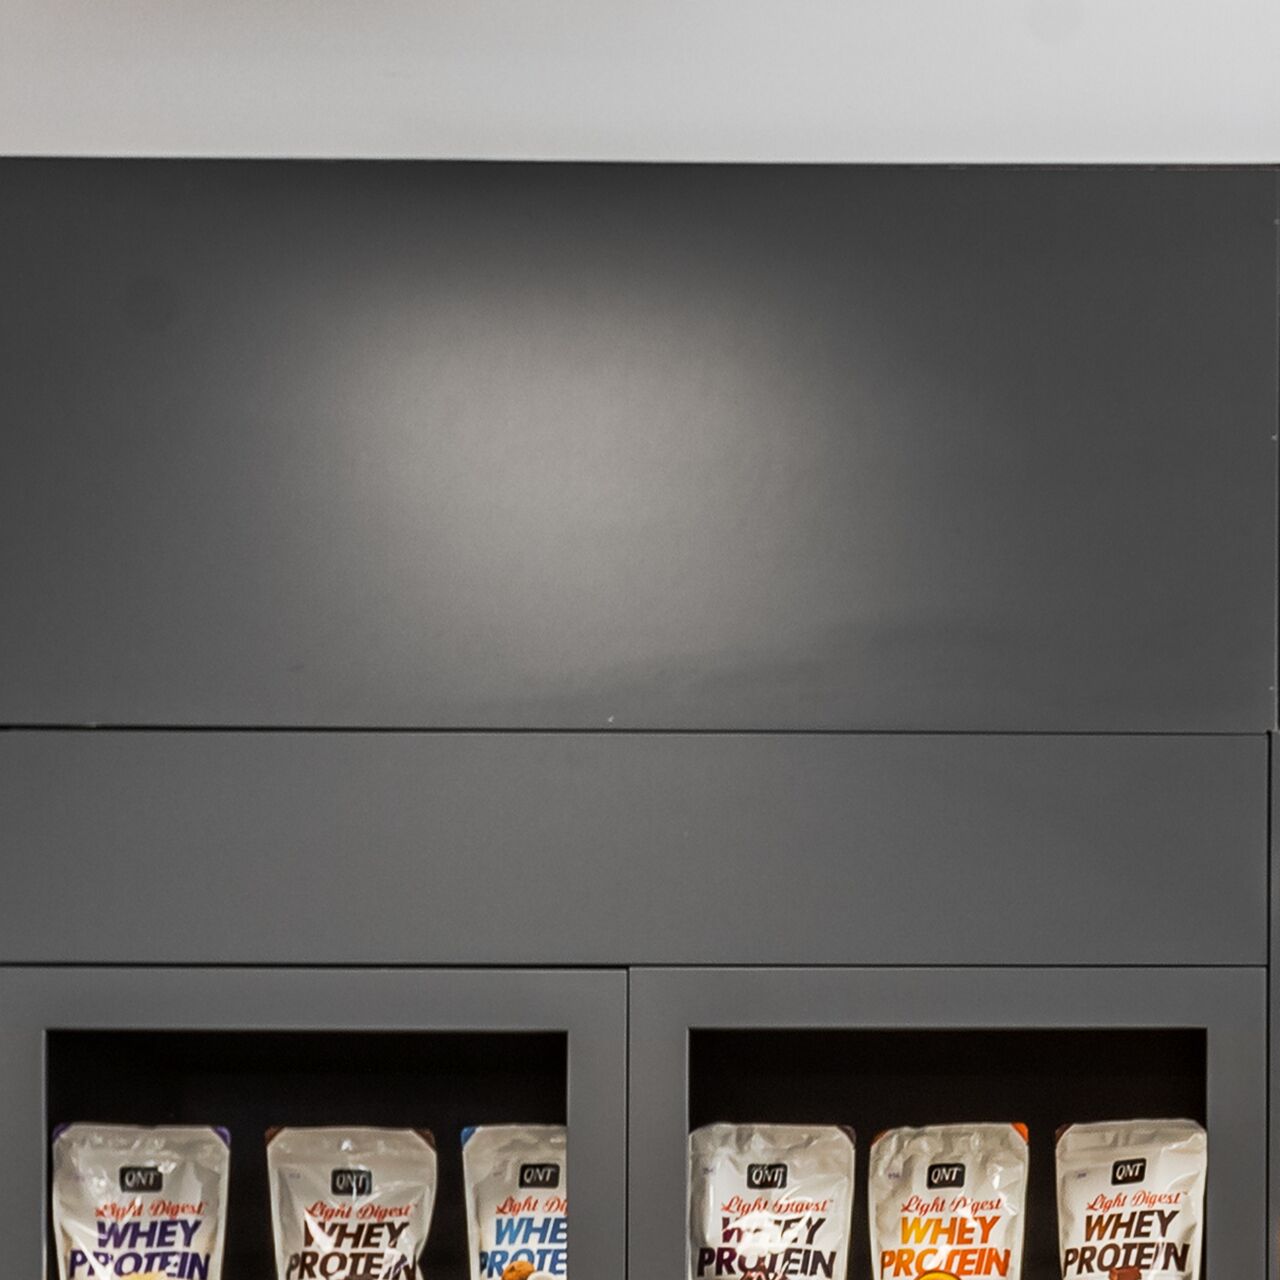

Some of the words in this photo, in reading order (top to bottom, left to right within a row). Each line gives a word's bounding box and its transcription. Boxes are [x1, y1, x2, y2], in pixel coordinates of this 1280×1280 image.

[124, 1170, 158, 1187] QNT
[523, 1168, 555, 1183] QNT
[931, 1168, 960, 1184] QNT
[1115, 1162, 1143, 1181] QNT
[150, 1200, 205, 1220] Digest
[496, 1196, 539, 1215] Light
[721, 1195, 768, 1215] Light
[901, 1195, 945, 1216] Light
[951, 1197, 1002, 1215] Dgest
[1087, 1193, 1127, 1212] Light
[1132, 1190, 1183, 1208] Digest
[307, 1203, 352, 1220] Light
[358, 1204, 412, 1221] Digest
[97, 1220, 200, 1248] WHEY
[304, 1221, 409, 1248] WHEY
[900, 1216, 1001, 1245] WHEY
[1085, 1210, 1179, 1242] WHEY
[696, 1247, 837, 1279] PROTEIN
[880, 1248, 1012, 1279] PROTEIN
